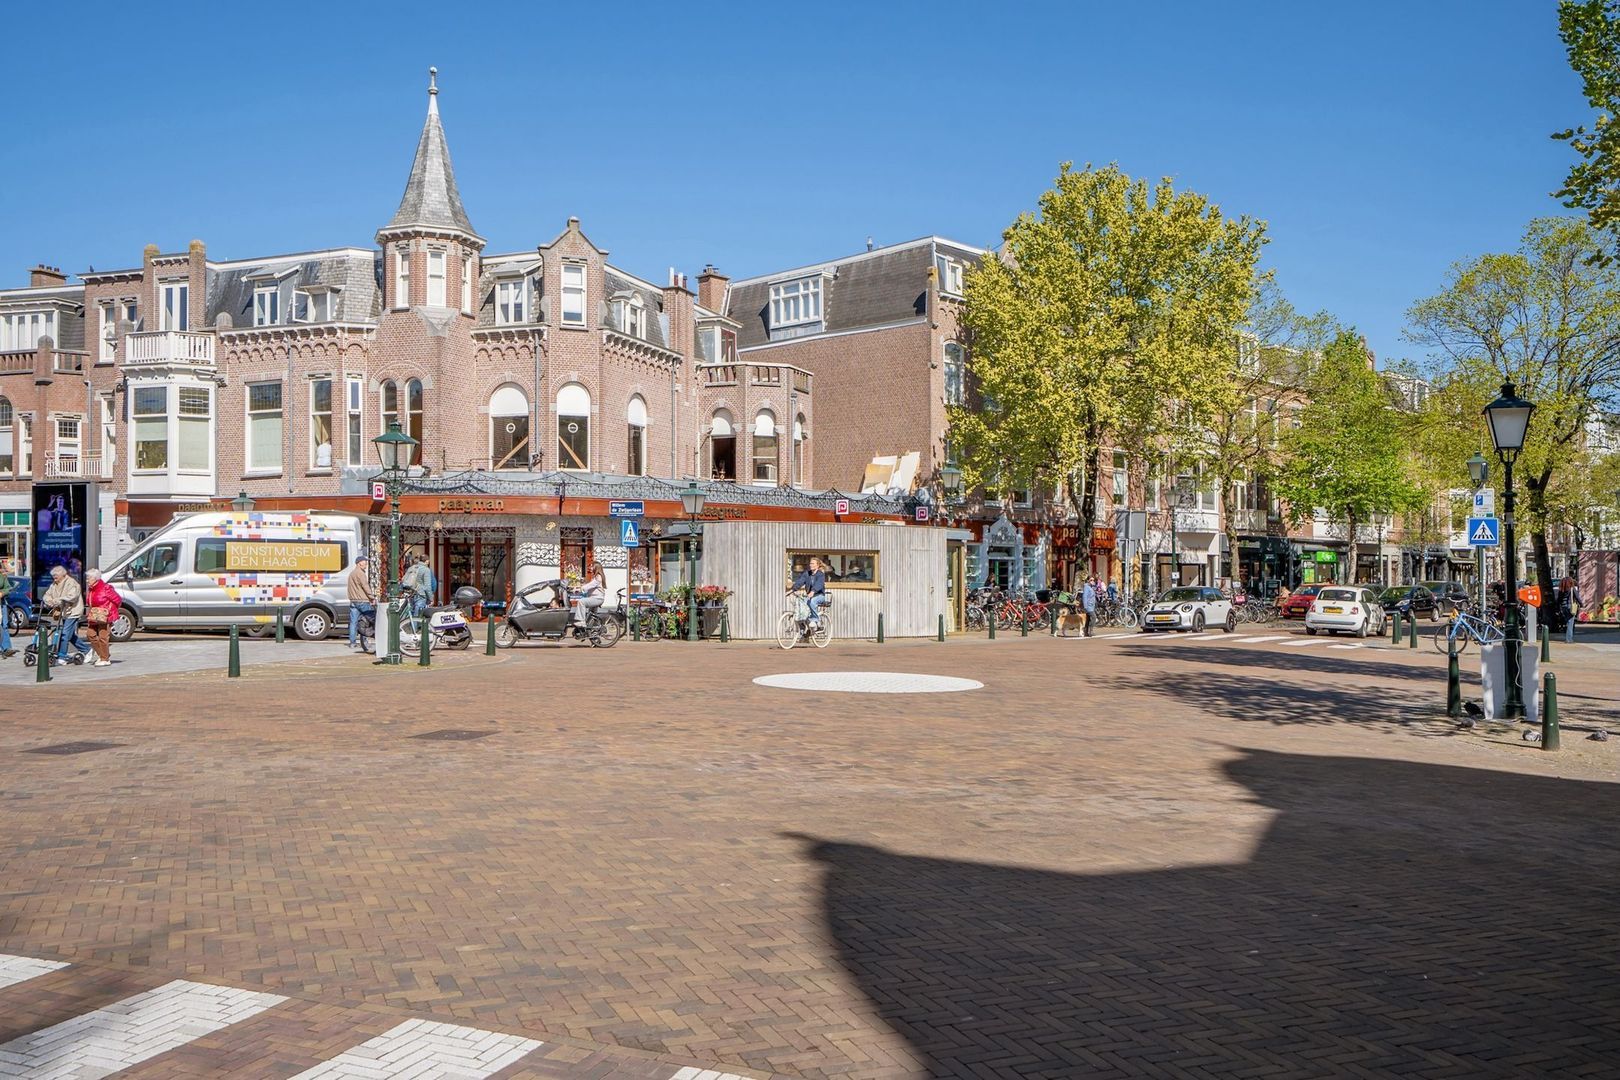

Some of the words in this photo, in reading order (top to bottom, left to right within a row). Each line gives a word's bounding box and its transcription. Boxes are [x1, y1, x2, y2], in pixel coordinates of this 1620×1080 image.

[439, 499, 504, 512] paagman
[703, 507, 748, 520] aagman
[231, 545, 330, 557] KUNSTMUSEUM
[231, 556, 258, 567] DEN
[263, 557, 297, 567] HAAG
